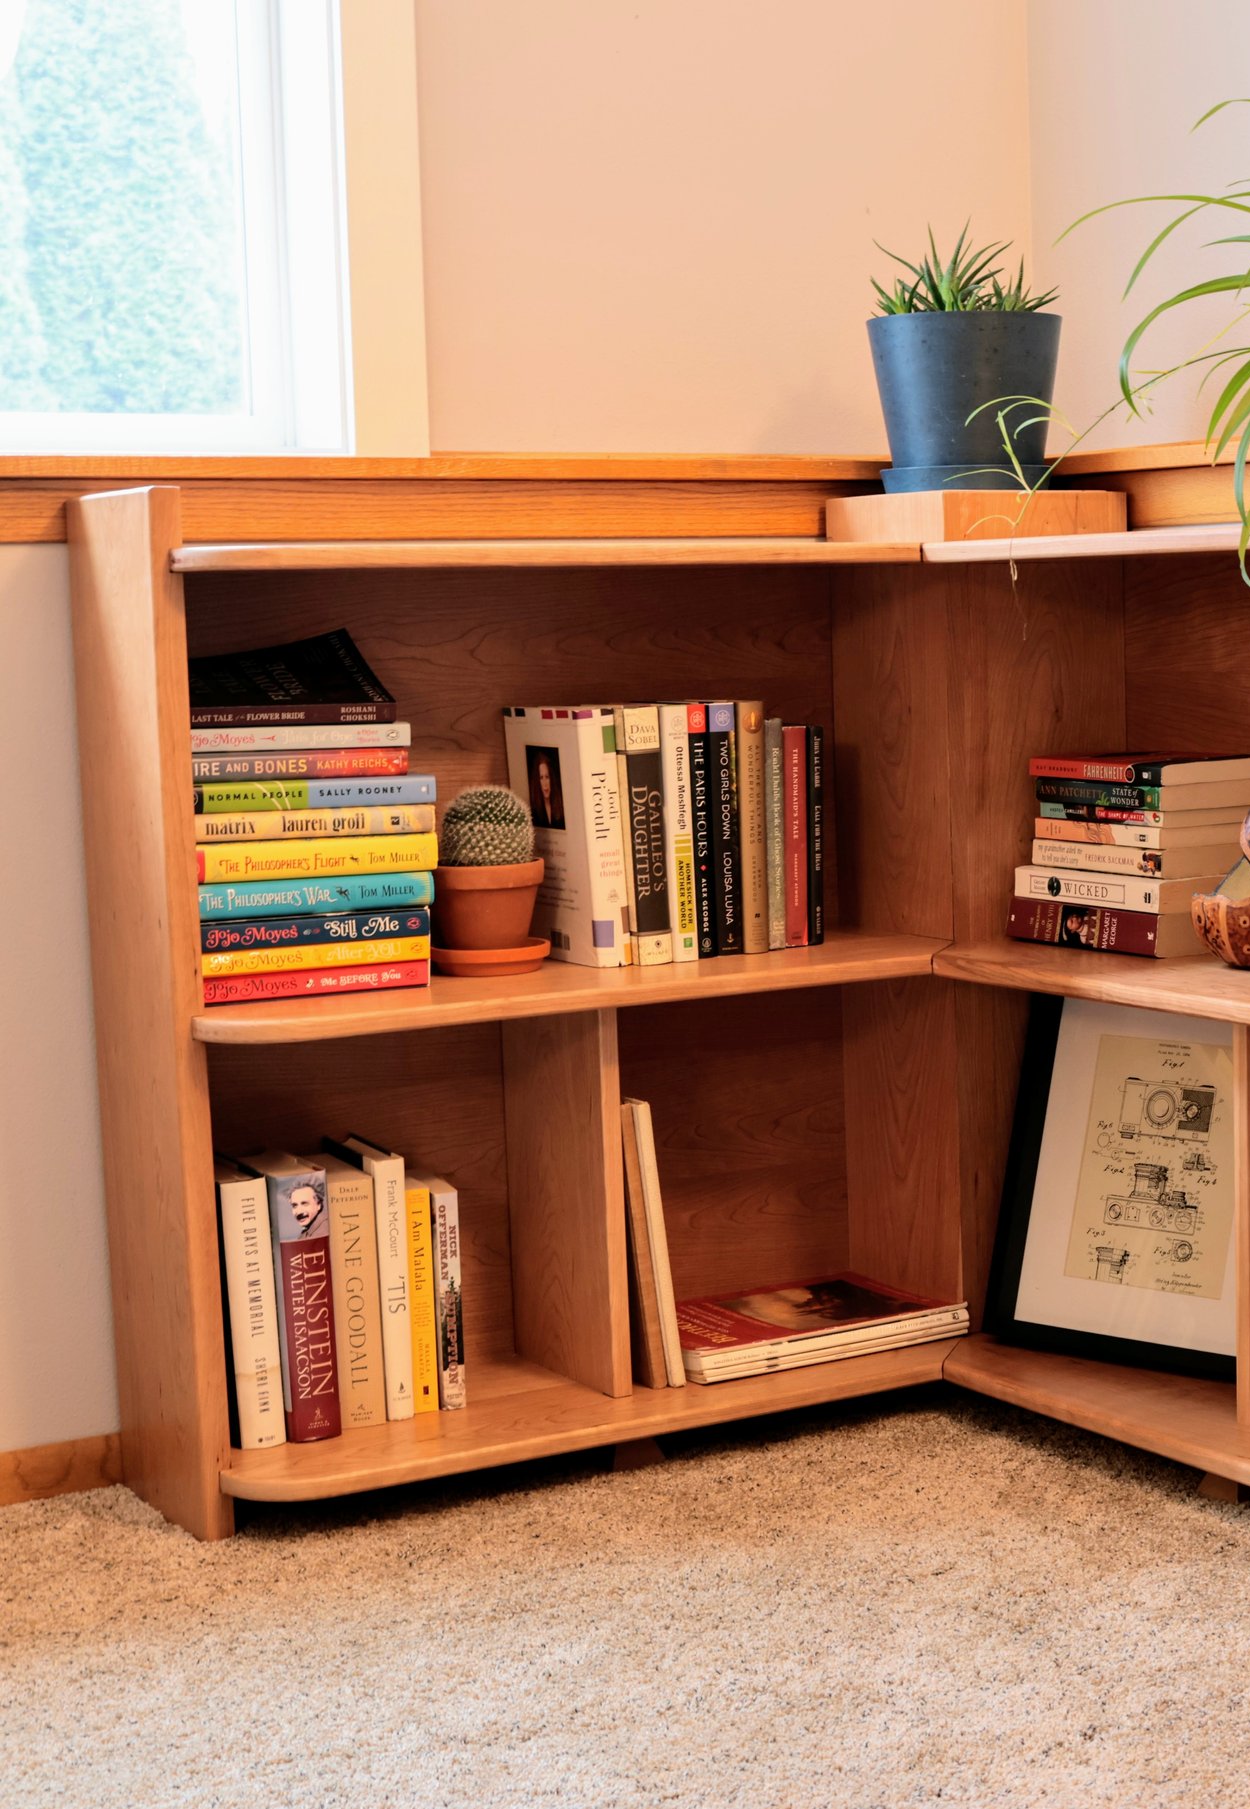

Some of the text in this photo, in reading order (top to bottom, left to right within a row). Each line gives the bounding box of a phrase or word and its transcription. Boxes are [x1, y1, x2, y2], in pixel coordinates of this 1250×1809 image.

[213, 714, 233, 722] TALE
[247, 713, 280, 721] FLOWER
[281, 712, 305, 720] BRIDE
[630, 724, 656, 734] DAVA
[628, 735, 657, 745] SOBEL
[694, 741, 703, 770] THE
[194, 758, 388, 776] IRE AND BONES KATHY REICHS
[676, 746, 684, 783] Ottessa
[1083, 764, 1123, 780] FAHRENHEIT
[208, 786, 402, 801] NORMAL PEOPLE SALLY ROONEY
[608, 788, 620, 820] Jodi
[695, 770, 705, 808] PARIS
[1041, 785, 1138, 799] ANN PATCHETT STATE of
[1111, 797, 1140, 806] WONDER
[591, 772, 611, 840] Picoult
[678, 784, 686, 830] Moshfegh
[205, 817, 255, 835] matrix
[282, 815, 327, 833] lauren
[647, 790, 665, 892] GALILEO'S
[696, 812, 708, 858] HOURS
[720, 740, 734, 926] TWO GIRLS DOWN LOUISA LUNA
[631, 785, 651, 900] DAUGHTER
[219, 851, 420, 874] THE PHILOSOPHER'S FLIGHT TOM MILLER
[199, 883, 415, 912] THE PHILOSOPHER'S WAR TOM MILLER
[685, 863, 693, 905] HOMESICK
[1064, 882, 1108, 898] WICKED
[206, 916, 399, 948] Jojo Moyes Still Me
[1102, 912, 1111, 949] MARGARET
[1109, 917, 1117, 945] GEORGE
[205, 969, 401, 1000] Jojo Moyes Me BEFORE You
[331, 1195, 368, 1203] PETERSON
[340, 1212, 362, 1268] JANE
[387, 1180, 406, 1314] Frank McCourt 'TIS
[412, 1224, 422, 1242] Am
[438, 1204, 450, 1281] OFFERMAN
[448, 1225, 457, 1258] NICK
[413, 1245, 426, 1291] Malala
[241, 1197, 270, 1413] FIVE DAYS AT MEMORIAL SHERI FINK
[289, 1253, 311, 1399] WALTER ISAACSON
[302, 1249, 334, 1397] EINSTEIN
[346, 1276, 368, 1389] GOODALL
